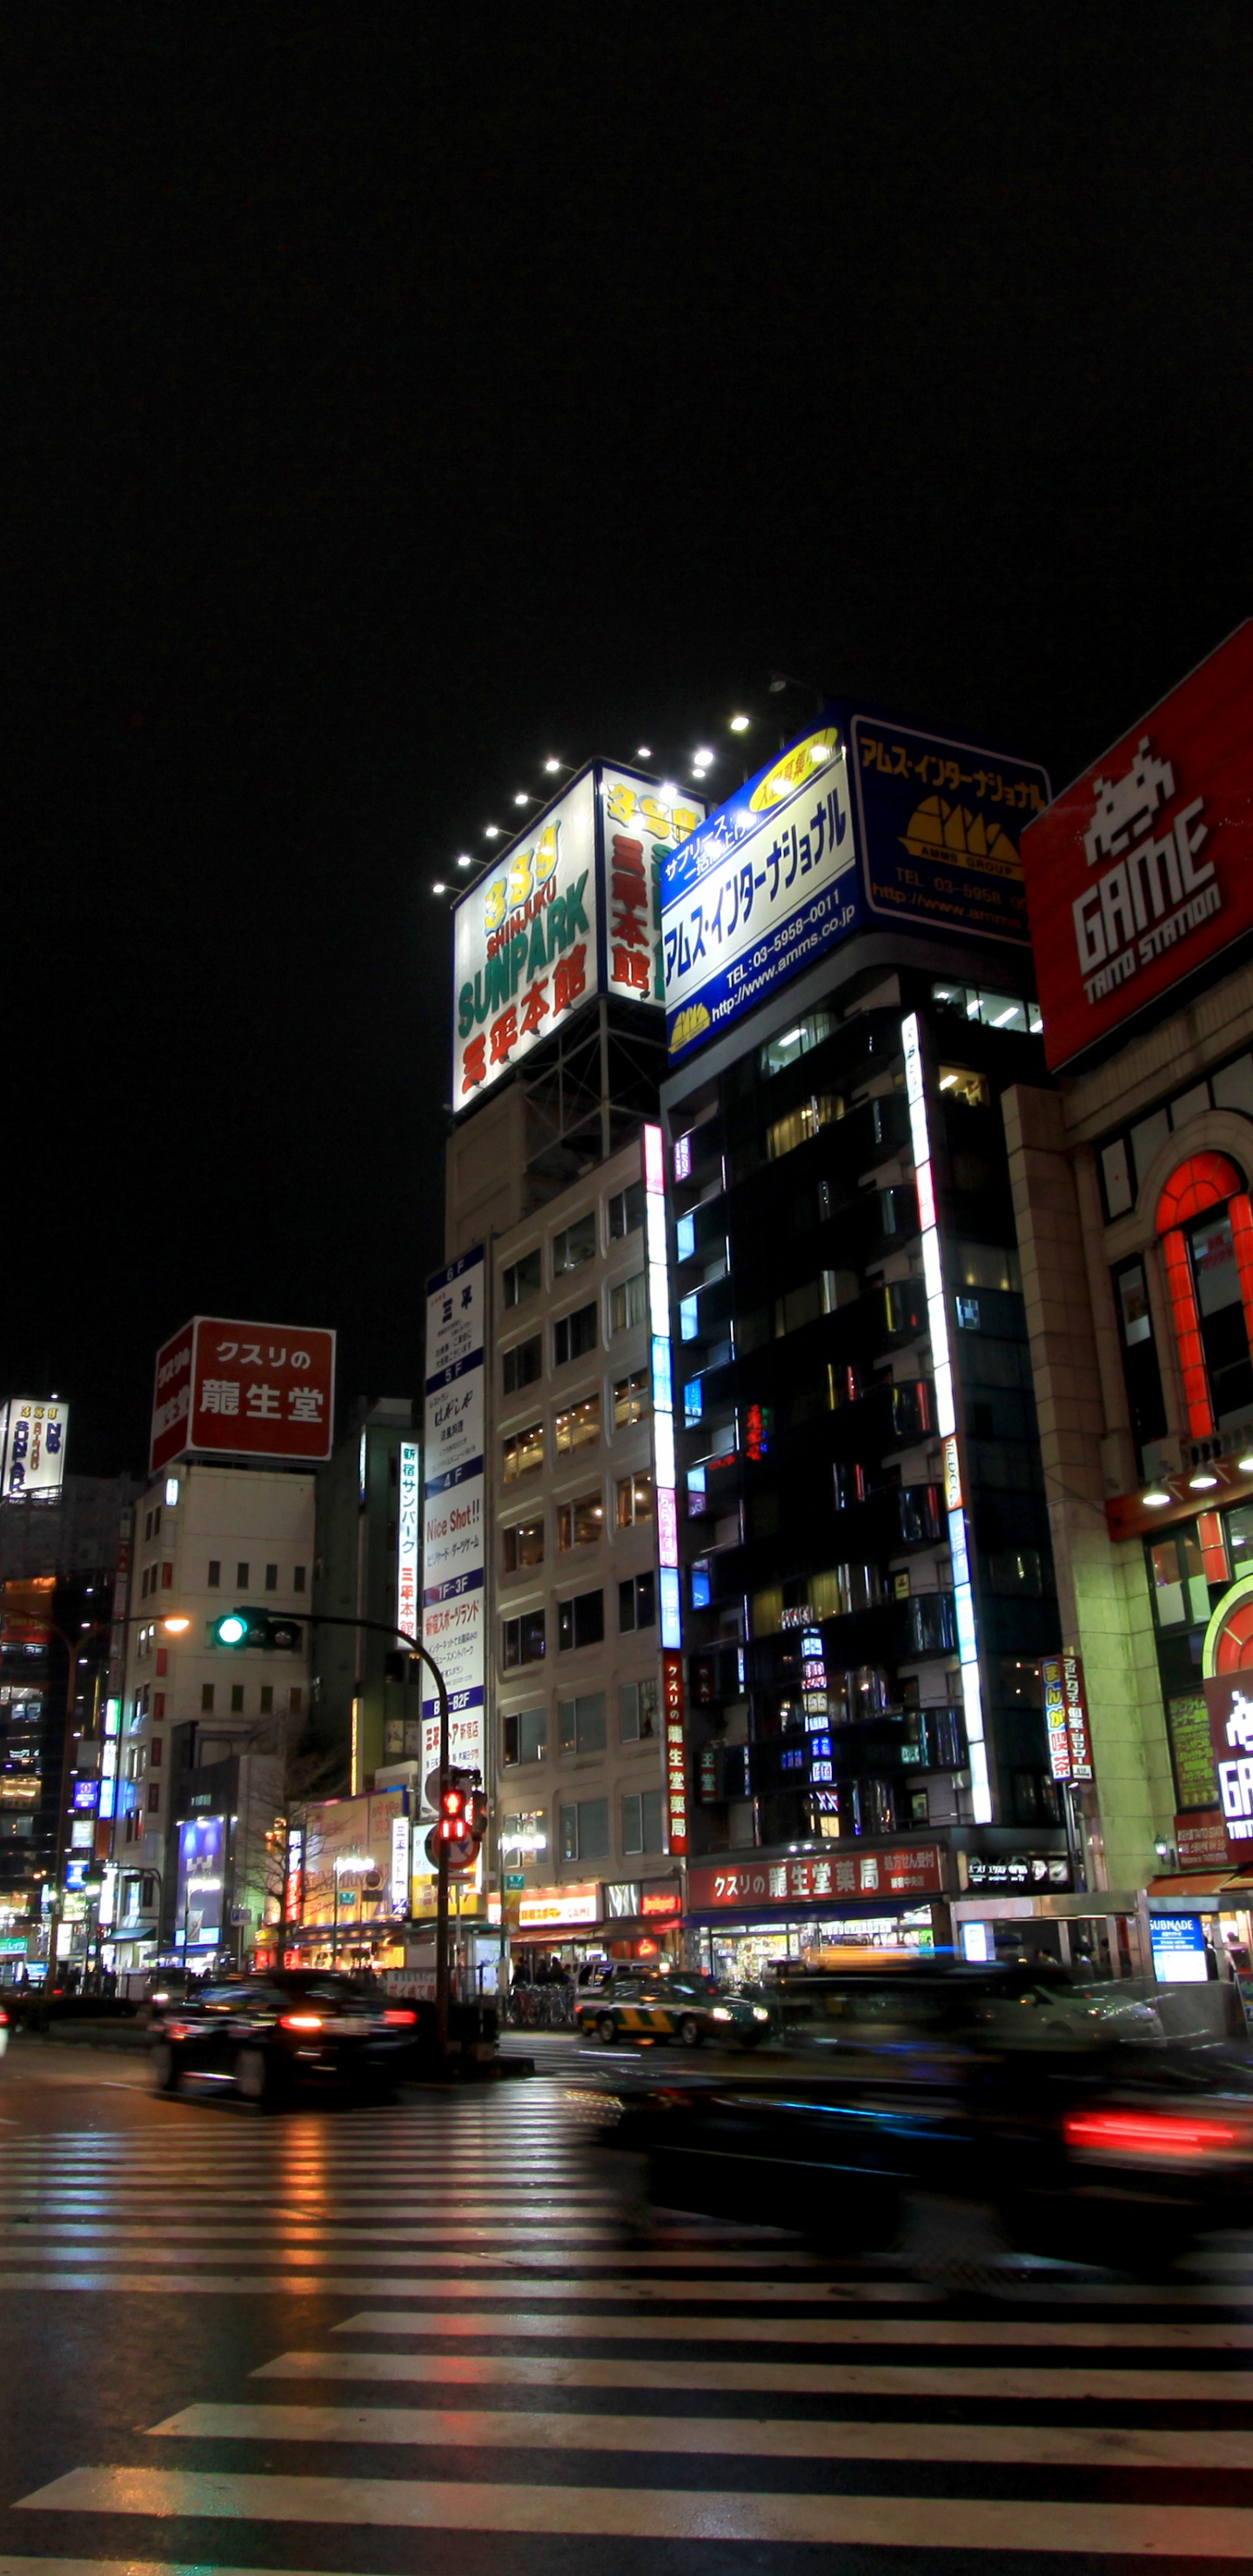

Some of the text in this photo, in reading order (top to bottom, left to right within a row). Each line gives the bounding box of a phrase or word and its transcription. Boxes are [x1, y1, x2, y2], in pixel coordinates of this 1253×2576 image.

[486, 876, 557, 959] SHINJUKU
[1072, 795, 1216, 976] GAME
[459, 869, 590, 1039] SUNPARK
[1084, 882, 1222, 1005] TAITO STATION
[462, 943, 587, 1094] 三平本館
[199, 1379, 324, 1424] 龍生堂
[216, 1342, 311, 1370] クスリの
[401, 1447, 416, 1553] 新宿サンパーク
[426, 1518, 447, 1543] Nice
